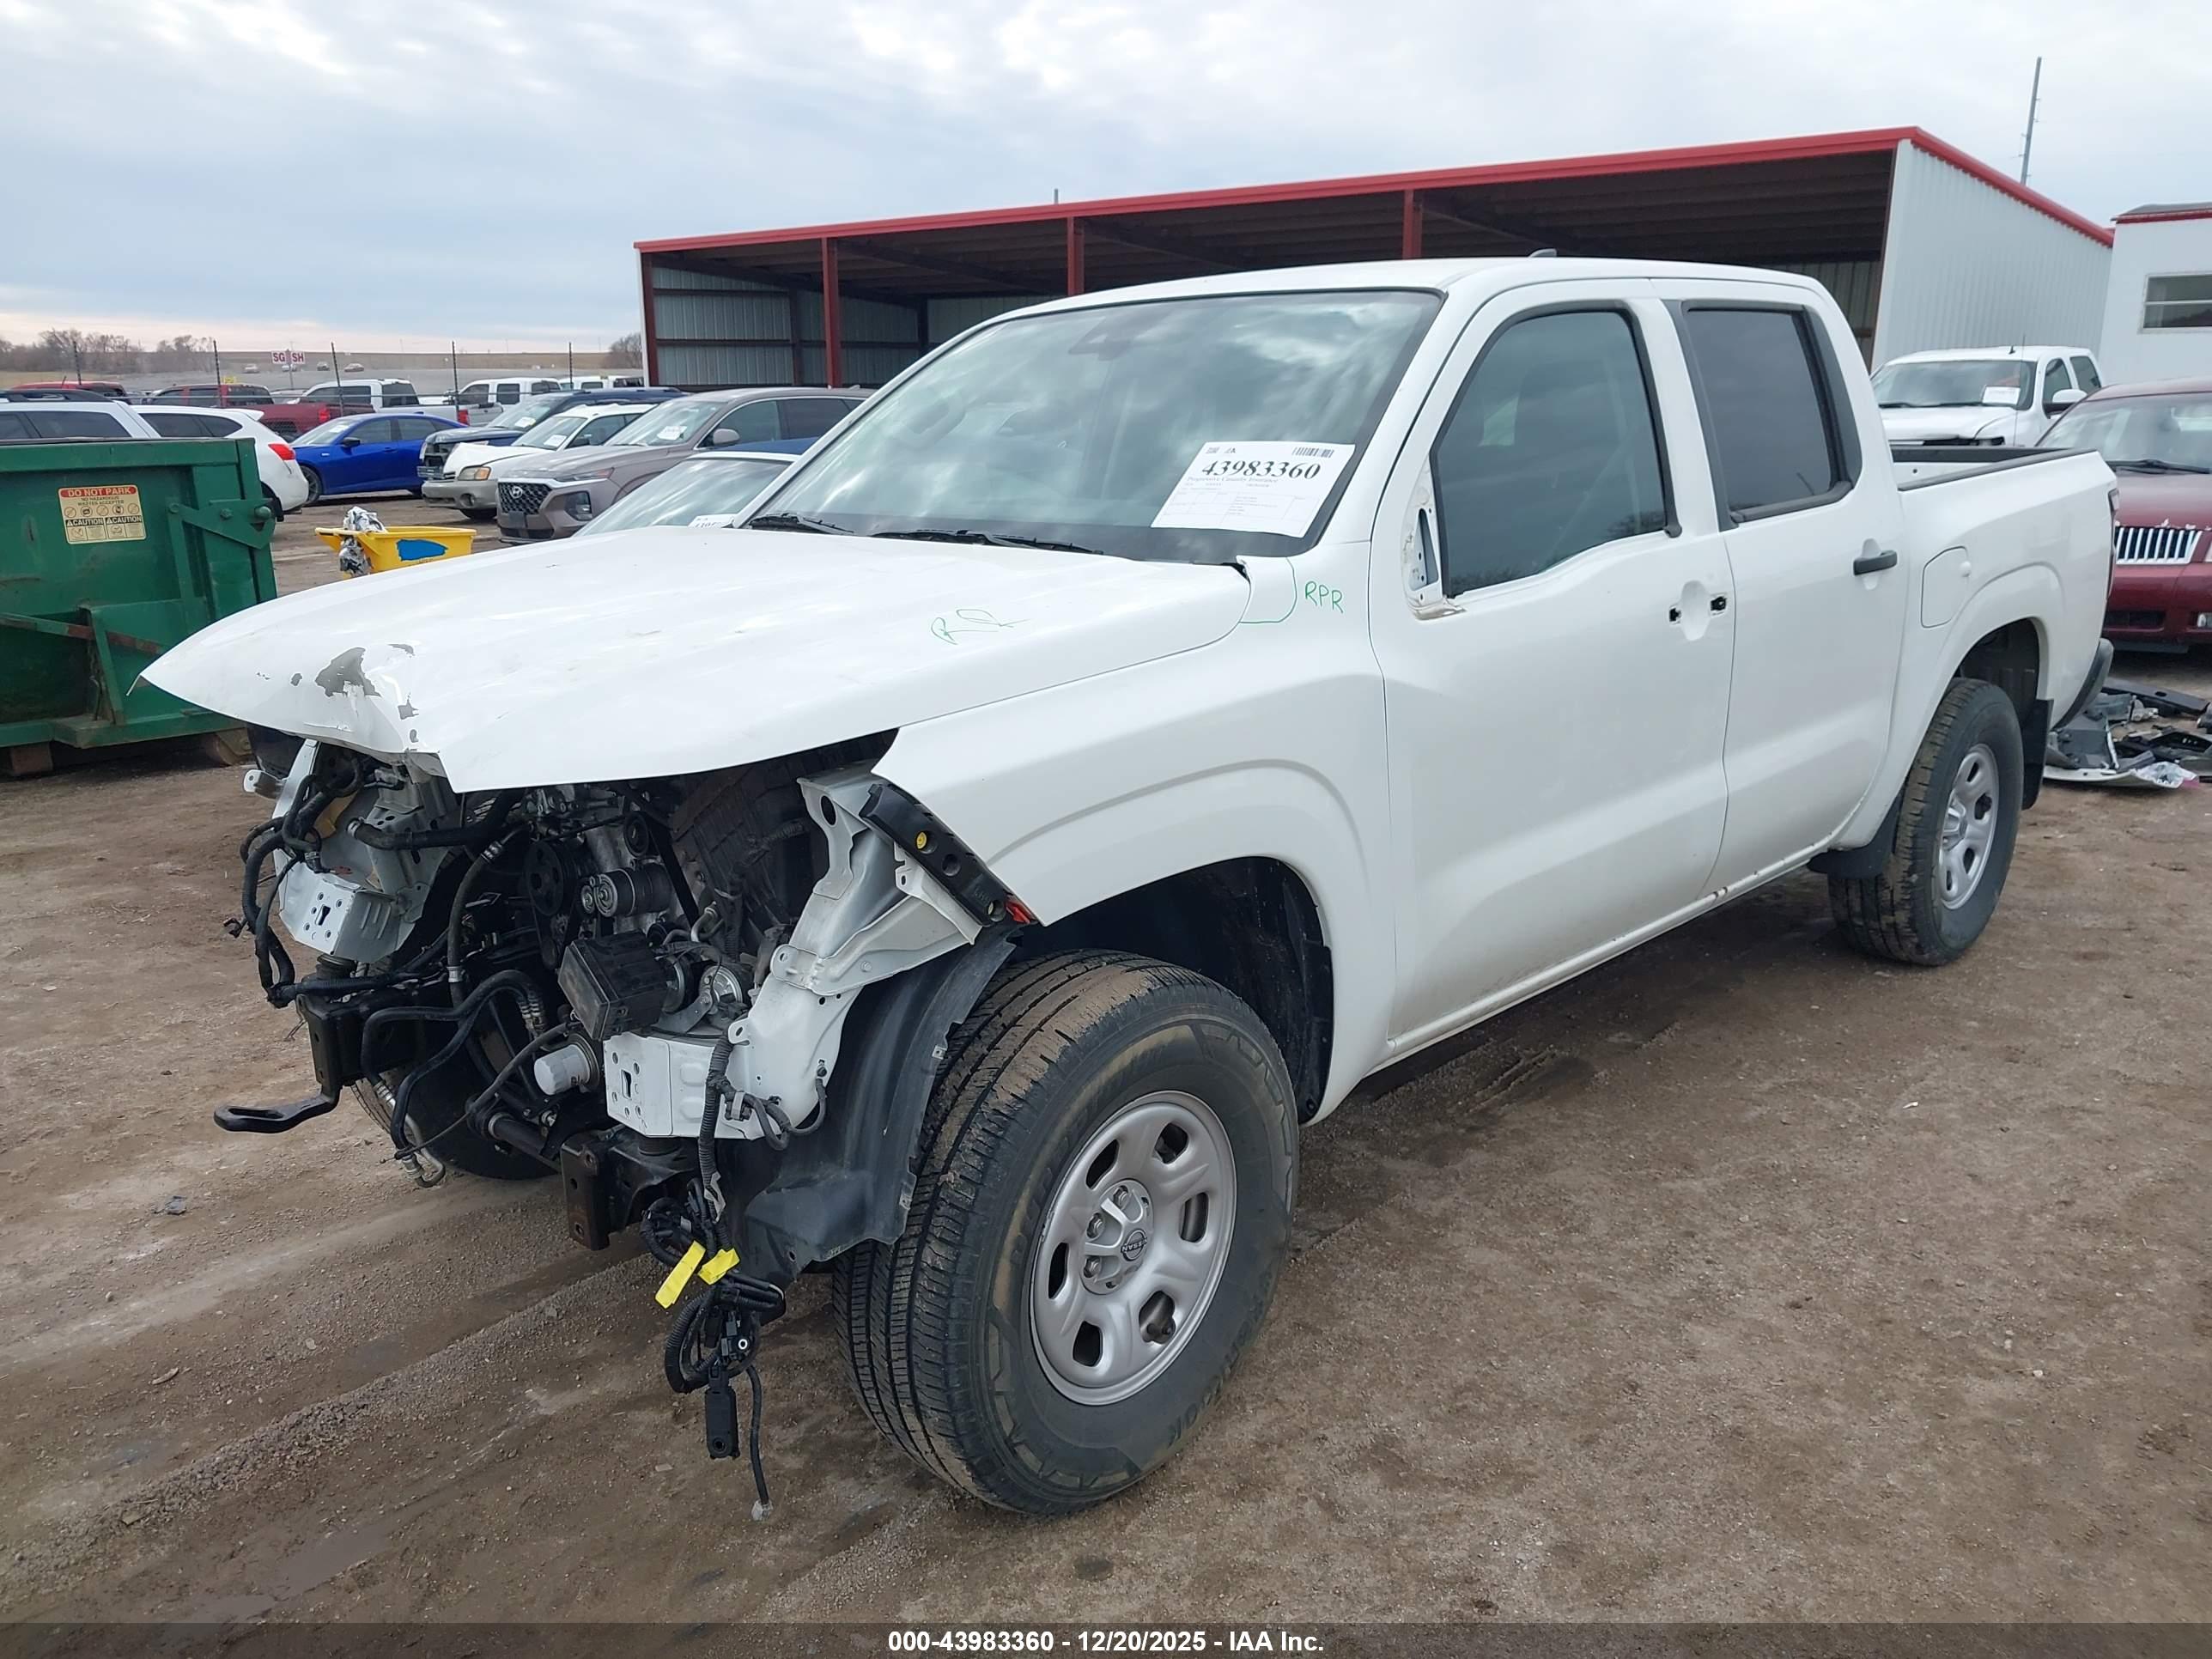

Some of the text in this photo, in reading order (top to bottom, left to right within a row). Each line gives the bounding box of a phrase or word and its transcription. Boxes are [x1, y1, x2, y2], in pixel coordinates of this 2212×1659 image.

[273, 352, 304, 362] SG SH
[1202, 460, 1321, 479] 43983360
[106, 487, 131, 495] PARK
[73, 518, 103, 526] CAUTION
[1305, 580, 1344, 614] RPR
